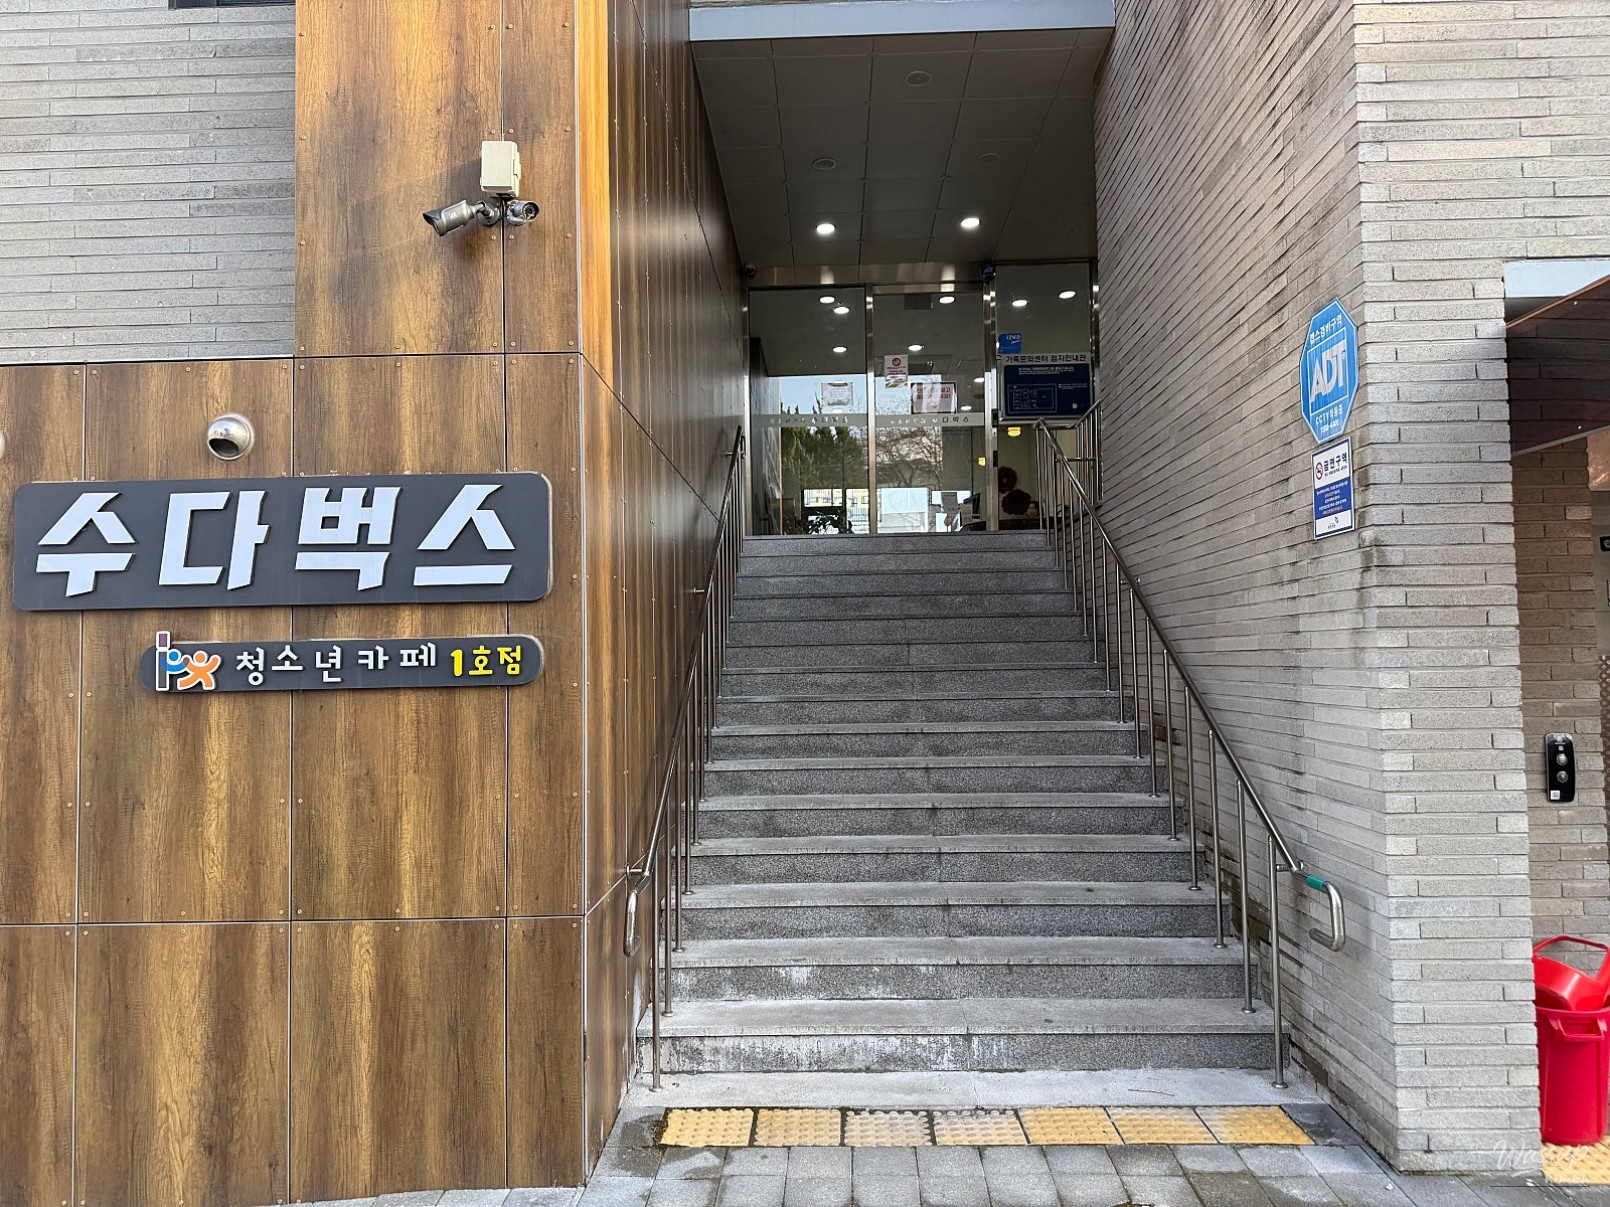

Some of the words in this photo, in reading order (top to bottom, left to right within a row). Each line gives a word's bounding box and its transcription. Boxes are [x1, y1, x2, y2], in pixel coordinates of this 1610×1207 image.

[1310, 340, 1346, 402] ADT
[1323, 452, 1347, 472] 금연구역
[36, 484, 515, 597] 수다벅스
[451, 645, 522, 677] 1호점
